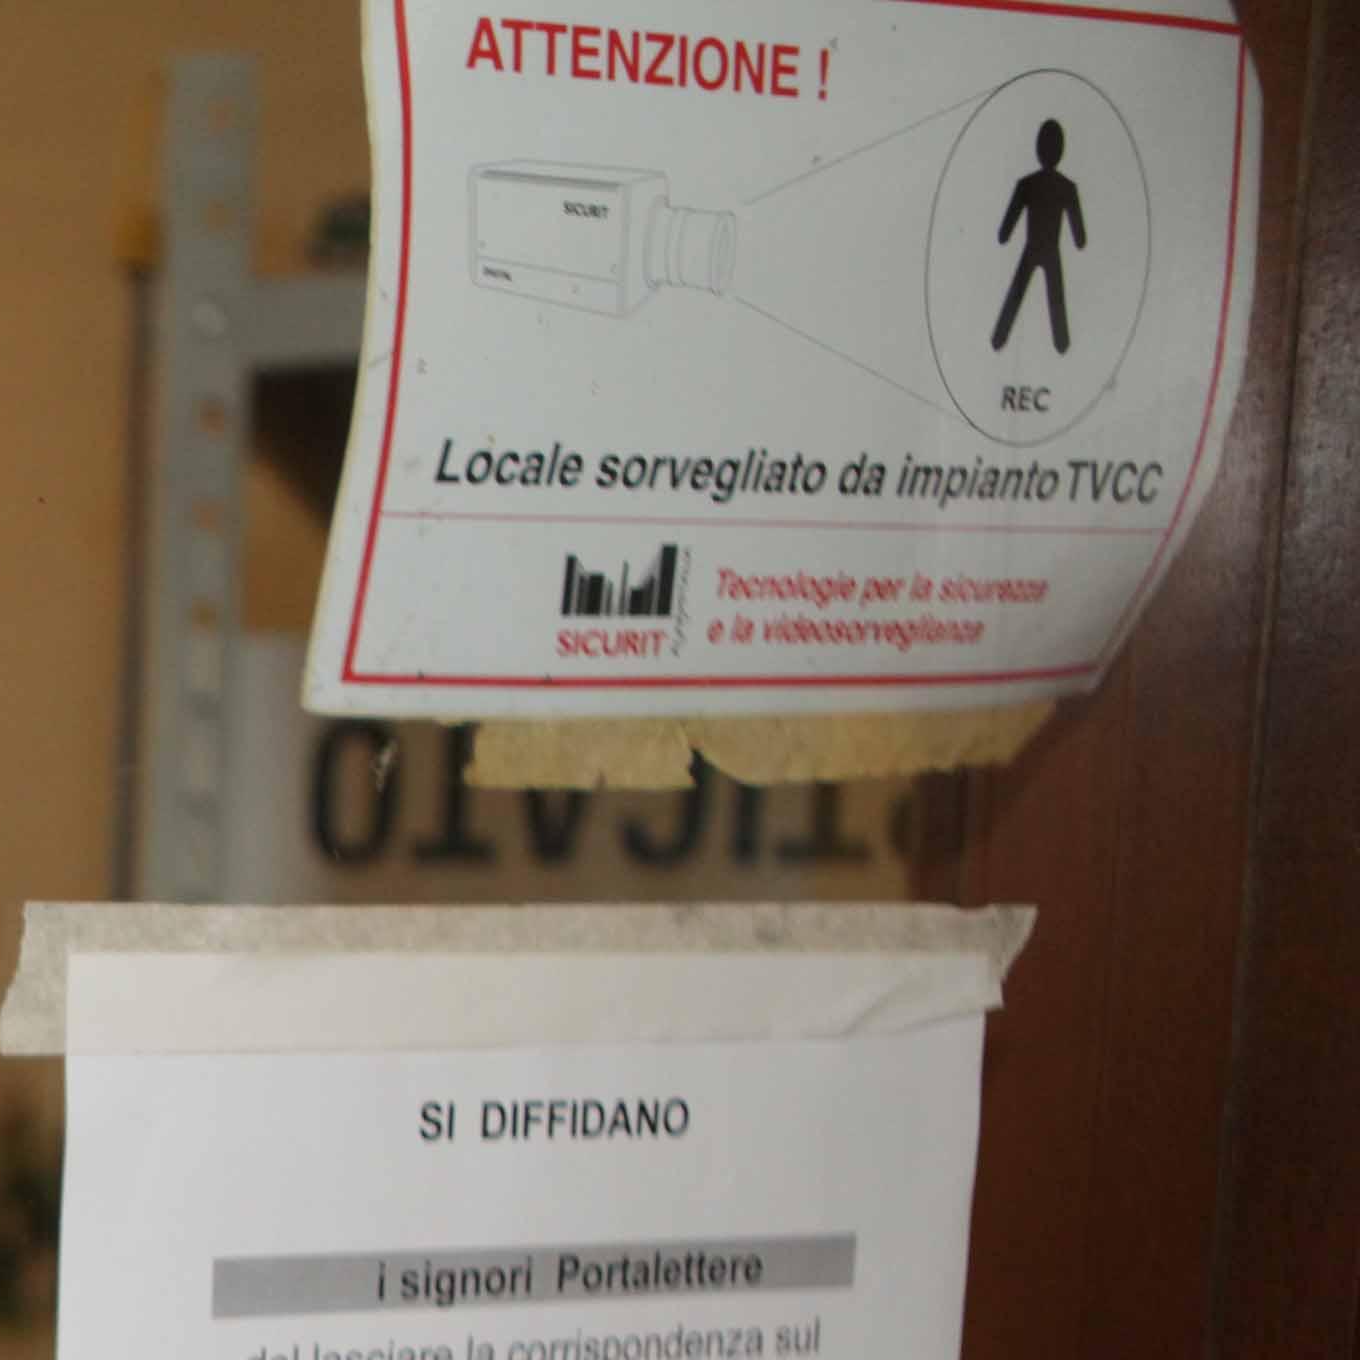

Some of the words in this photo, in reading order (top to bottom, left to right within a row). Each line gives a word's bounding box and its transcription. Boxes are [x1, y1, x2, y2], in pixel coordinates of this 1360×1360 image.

[466, 15, 800, 99] ATTENZIONE
[1001, 385, 1052, 413] REC
[435, 437, 584, 487] Locale
[594, 448, 827, 503] sorvegliato
[839, 452, 887, 497] da
[896, 453, 1060, 509] impianto
[1067, 459, 1164, 504] TVCC
[715, 567, 857, 609] Tecnologie
[859, 576, 906, 611] per
[910, 568, 934, 602] la
[556, 629, 669, 658] SICURIT
[707, 618, 723, 646] e
[730, 613, 754, 645] la
[418, 1100, 455, 1142] SI
[480, 1098, 691, 1141] DIFFIDANO
[377, 1263, 387, 1302] i
[400, 1255, 533, 1309] signori
[556, 1250, 764, 1293] Portalettere
[774, 1316, 821, 1357] sul
